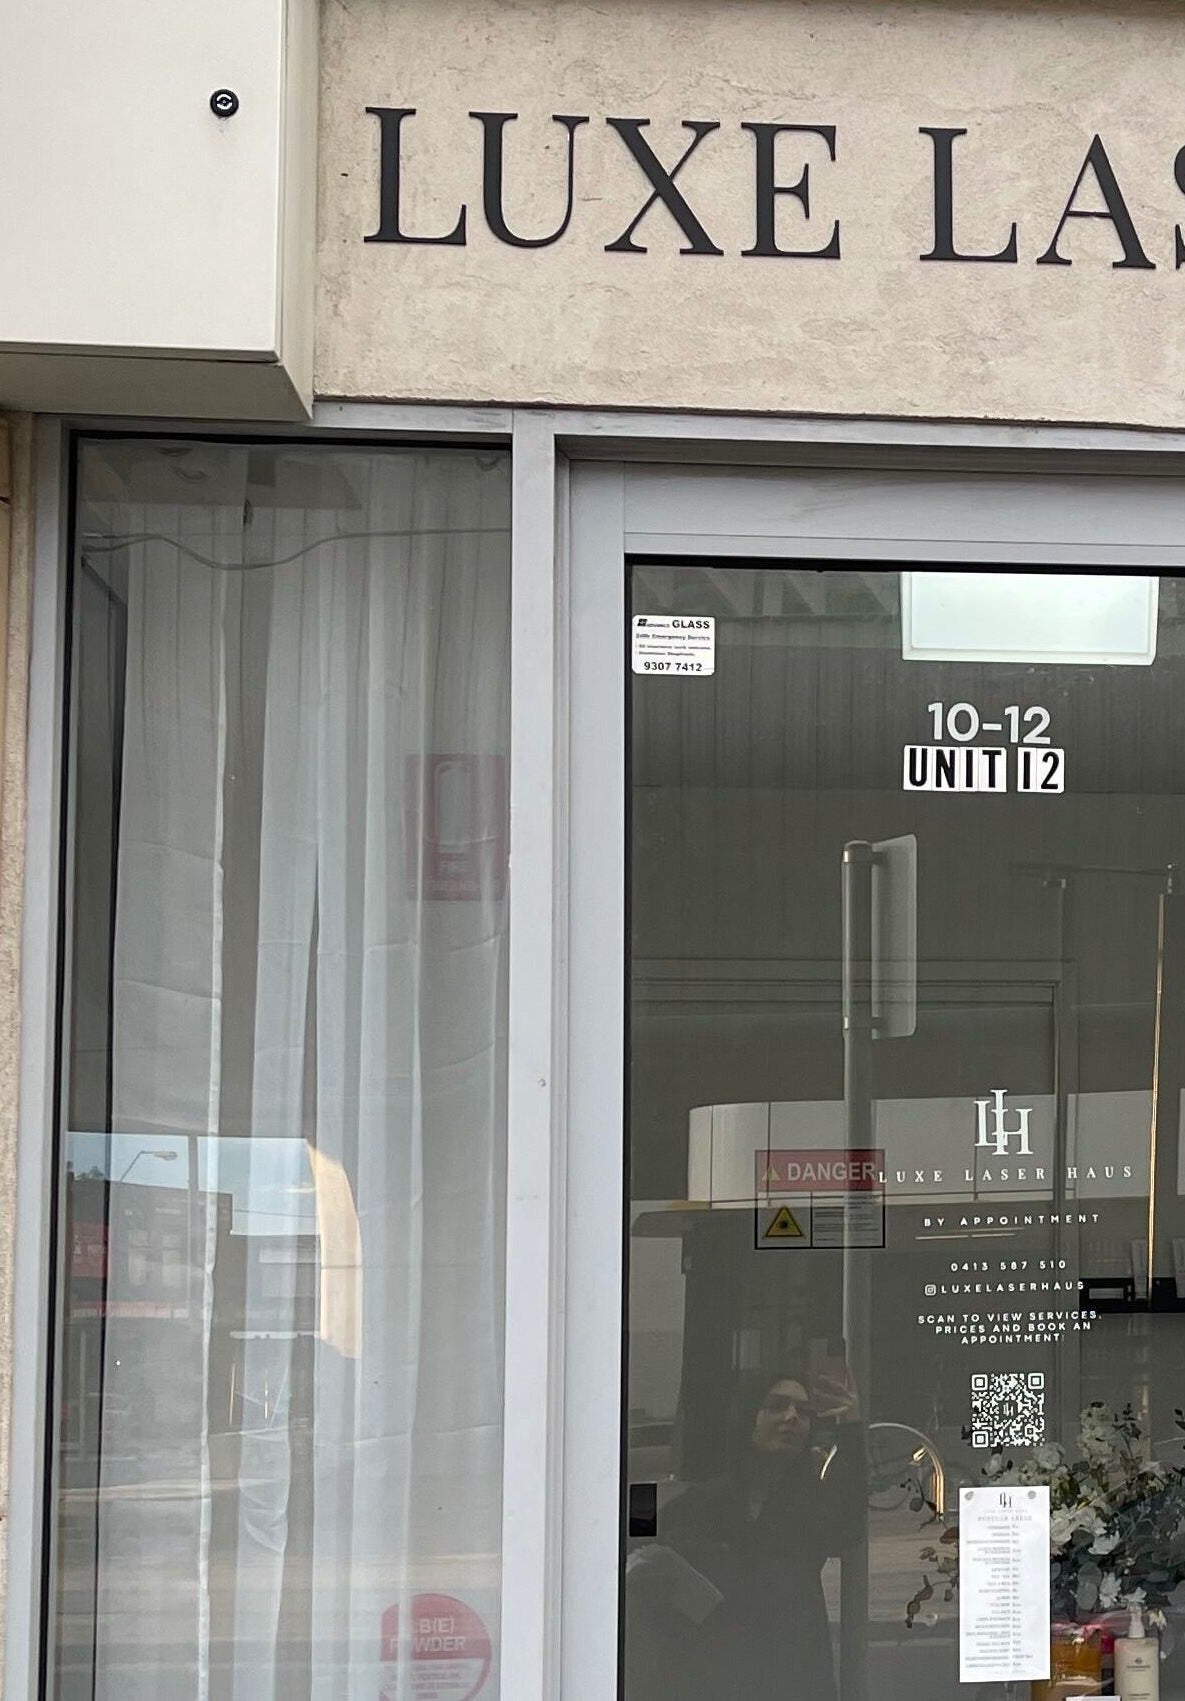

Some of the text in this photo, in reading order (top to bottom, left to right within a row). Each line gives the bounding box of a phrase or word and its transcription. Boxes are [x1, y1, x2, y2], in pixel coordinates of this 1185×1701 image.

[363, 106, 841, 260] LUXE
[672, 620, 710, 629] GLASS
[643, 661, 703, 672] 9307 7412
[927, 702, 1051, 743] 10-12
[908, 747, 1060, 790] UNIT 12
[787, 1162, 876, 1181] DANGER
[878, 1165, 1132, 1184] LUXE LASER HAUS
[923, 1213, 1101, 1228] BY APPOINTMENT
[950, 1261, 990, 1272] 0413
[1039, 1259, 1067, 1270] 510
[917, 1314, 956, 1325] SCAN
[962, 1313, 981, 1323] TO
[987, 1312, 1024, 1322] VIEW
[935, 1321, 1092, 1335] PRICES AND BOOK AN
[389, 1636, 467, 1653] PWDER
